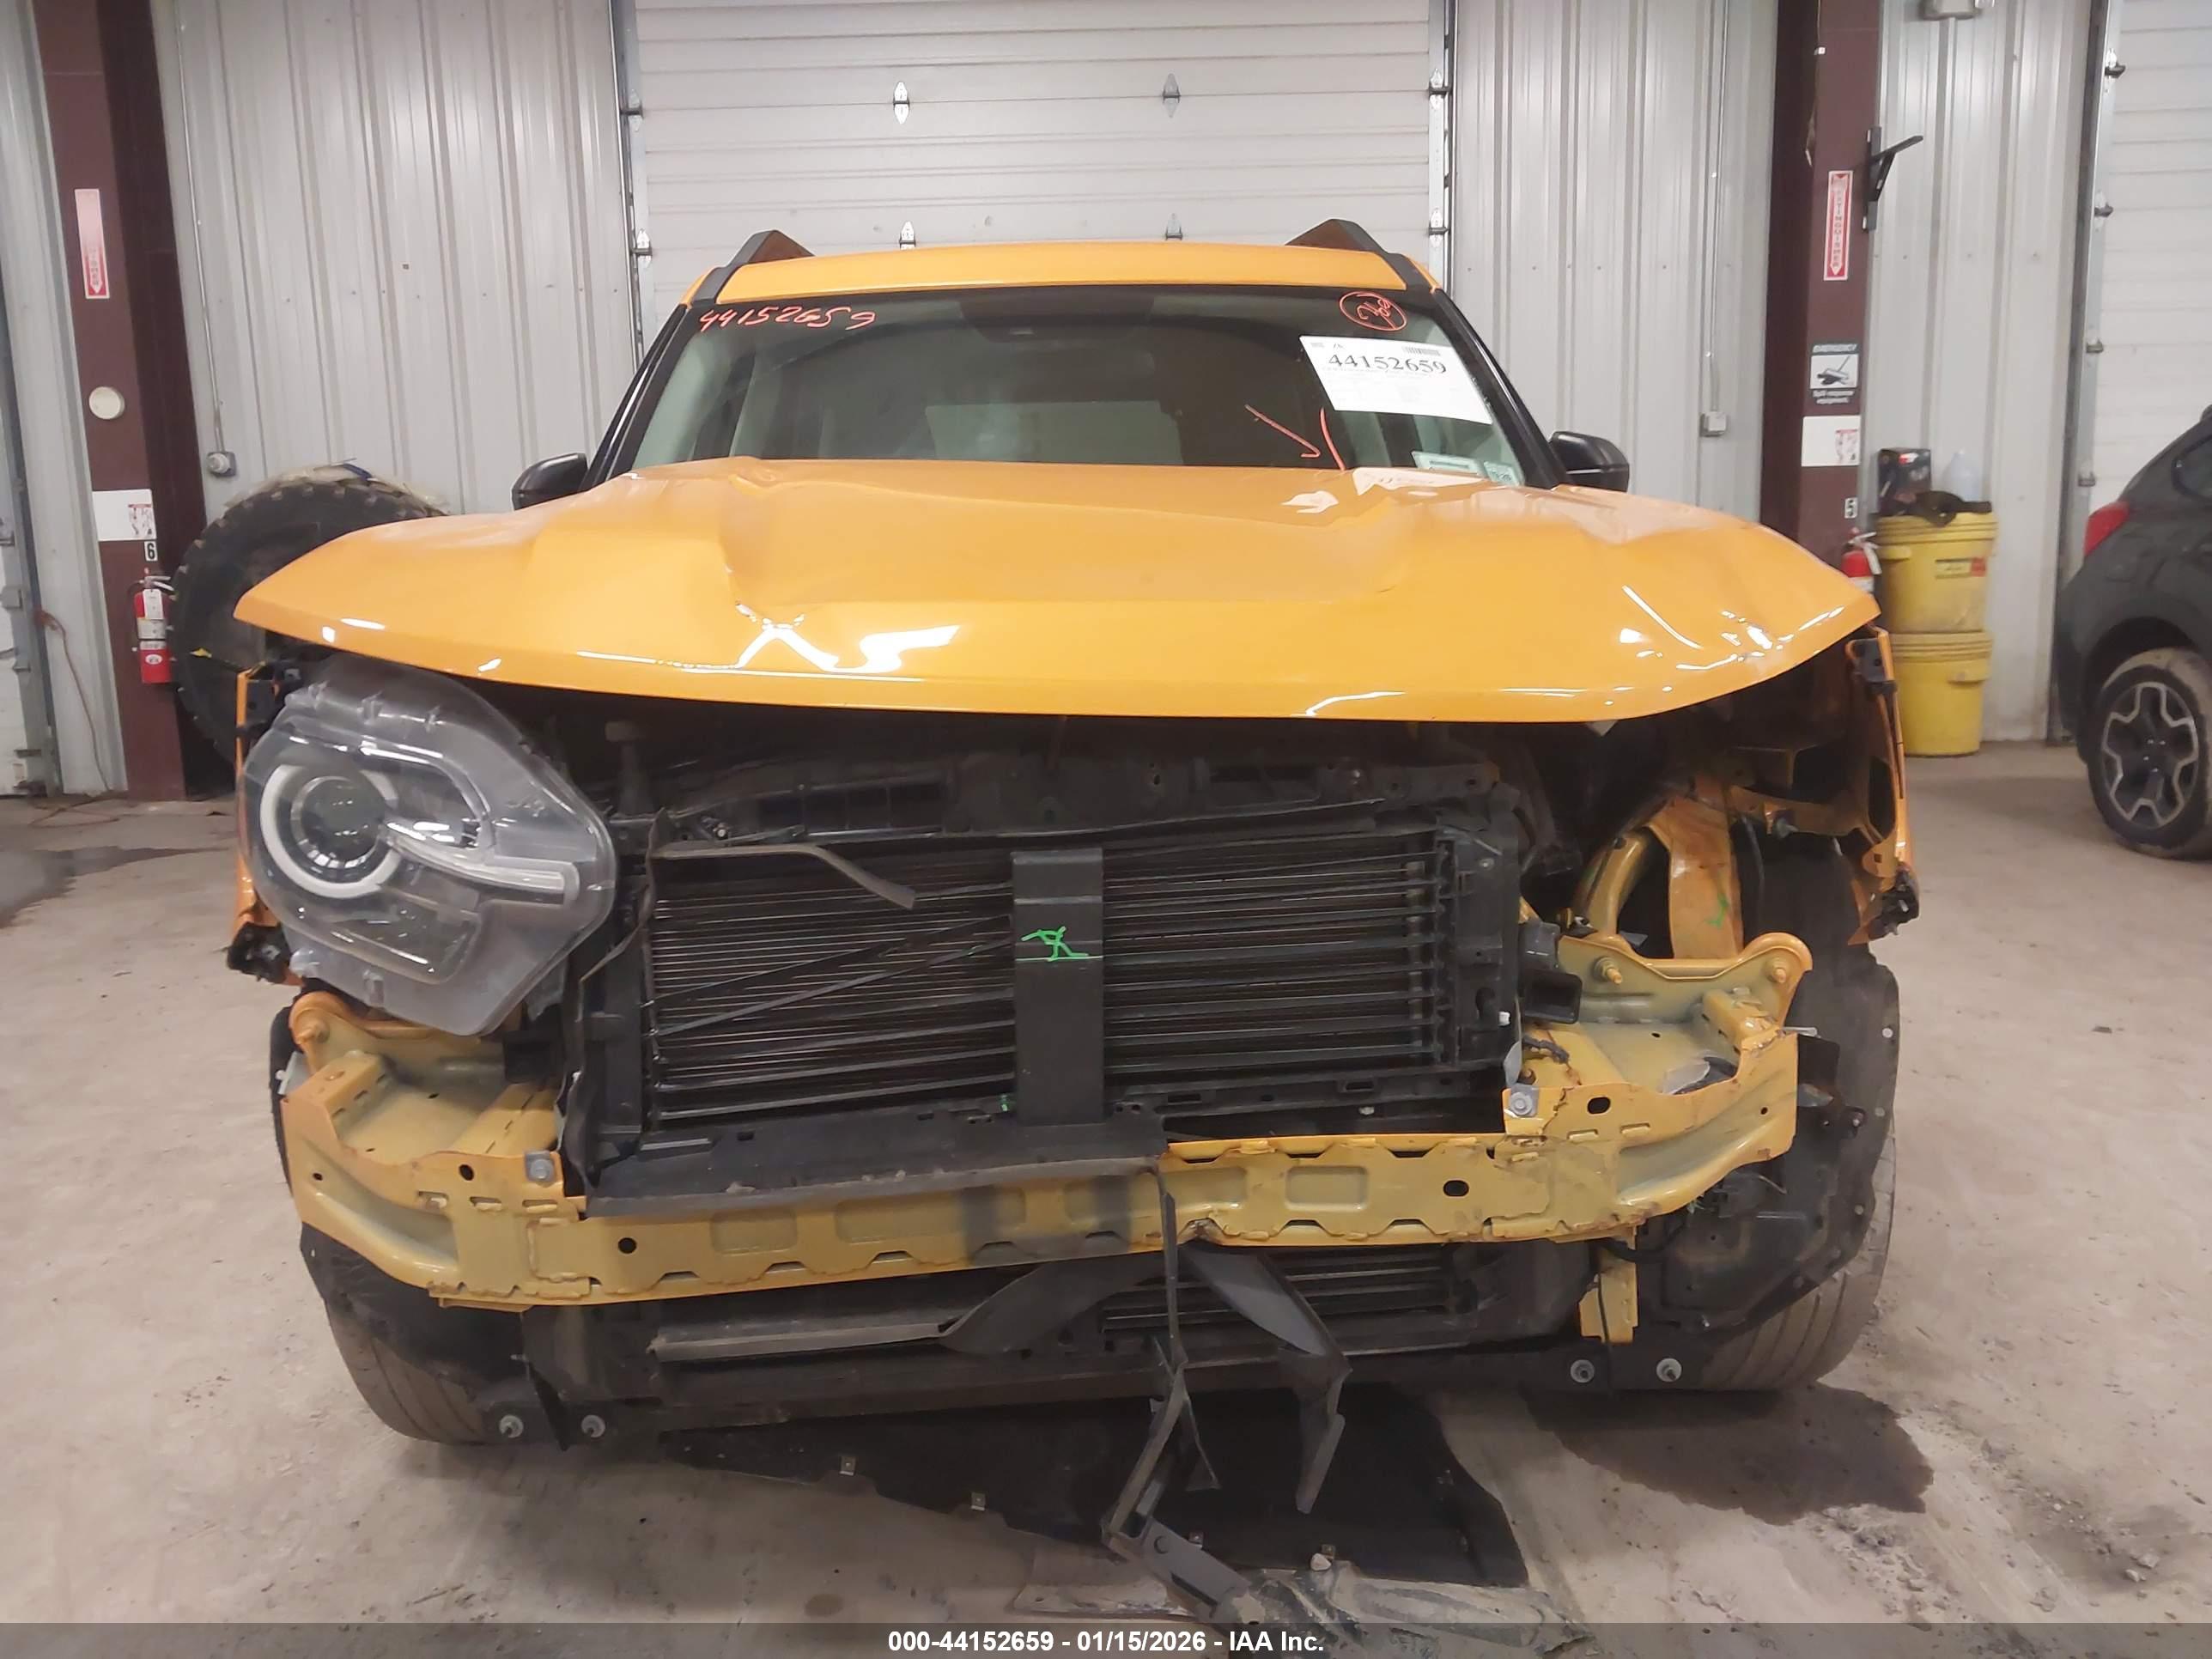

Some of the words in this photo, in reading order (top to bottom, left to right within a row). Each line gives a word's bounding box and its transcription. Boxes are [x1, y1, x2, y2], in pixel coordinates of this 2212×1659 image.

[1328, 353, 1448, 374] 44152659
[1846, 499, 1856, 517] 5
[147, 542, 156, 560] 6
